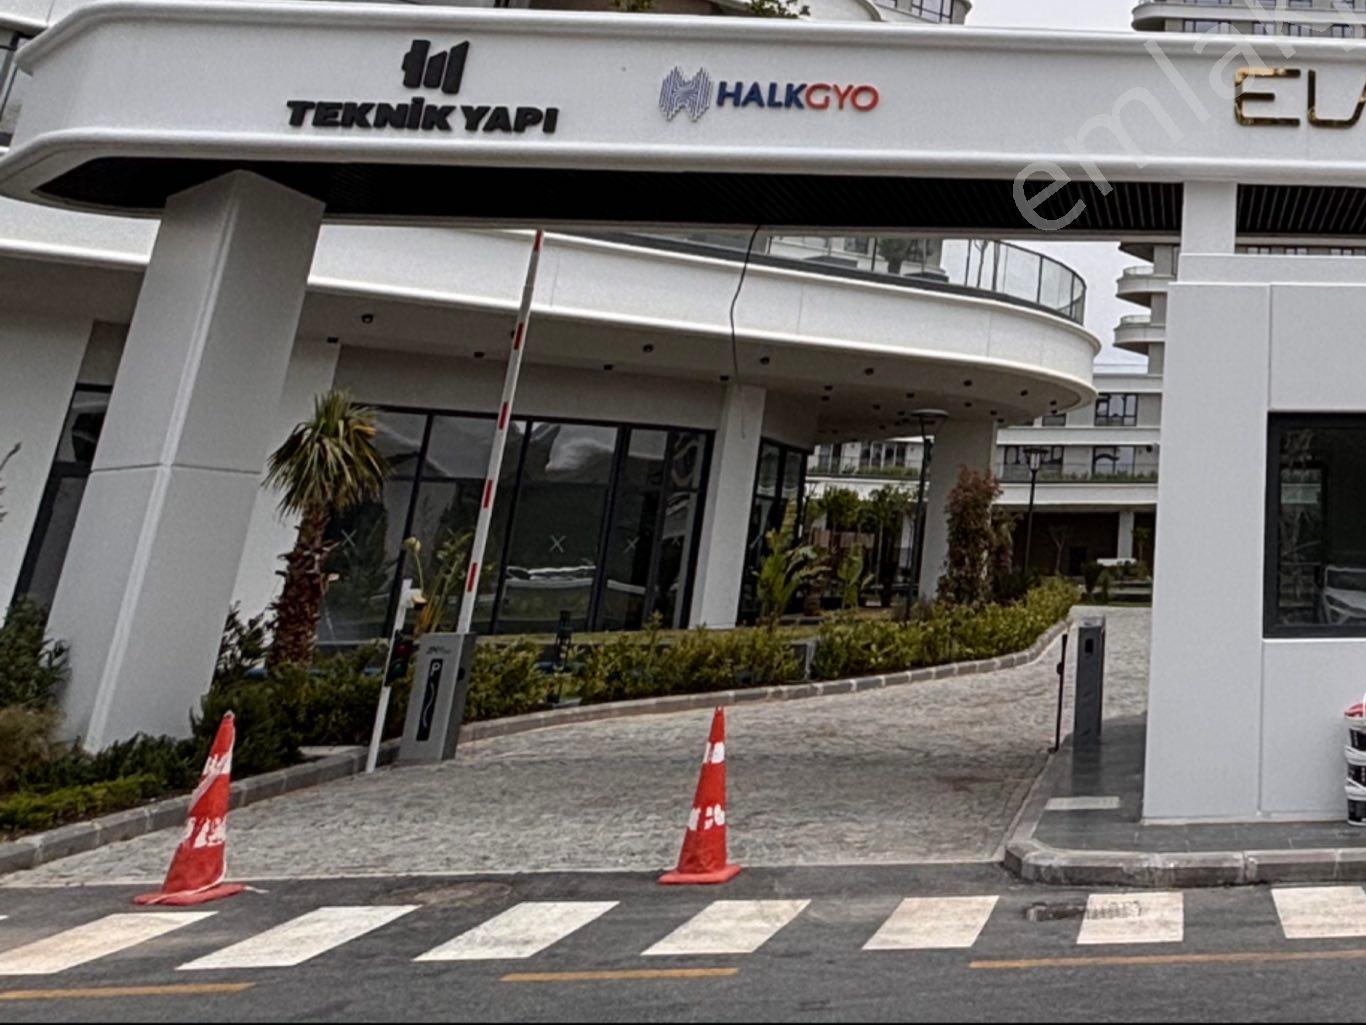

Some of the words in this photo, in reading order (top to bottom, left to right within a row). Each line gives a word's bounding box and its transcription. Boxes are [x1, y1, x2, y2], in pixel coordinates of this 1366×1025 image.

[716, 81, 880, 112] HALKGYO
[286, 96, 455, 131] TEKNİK
[461, 105, 559, 133] YAPI
